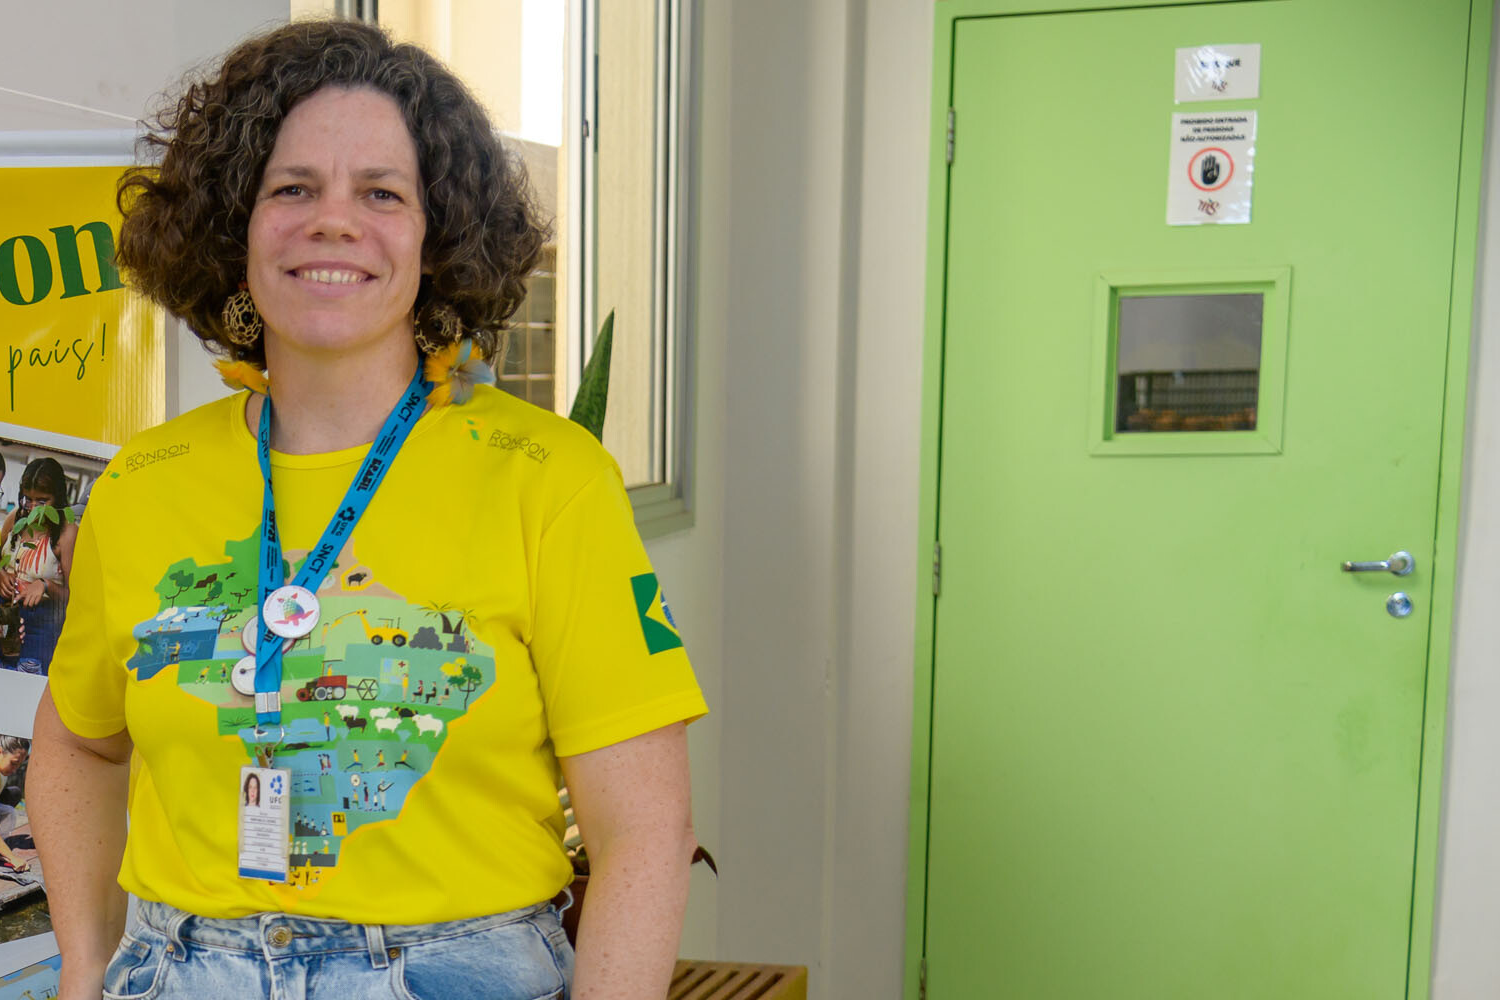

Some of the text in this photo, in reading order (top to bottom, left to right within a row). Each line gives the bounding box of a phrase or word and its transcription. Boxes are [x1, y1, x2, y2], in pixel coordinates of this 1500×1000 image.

[7, 322, 110, 412] país!
[398, 392, 420, 423] SNCT
[126, 441, 190, 470] RONDON
[488, 430, 551, 461] RONDON
[356, 458, 382, 492] BRASIL
[309, 543, 334, 574] SNCT
